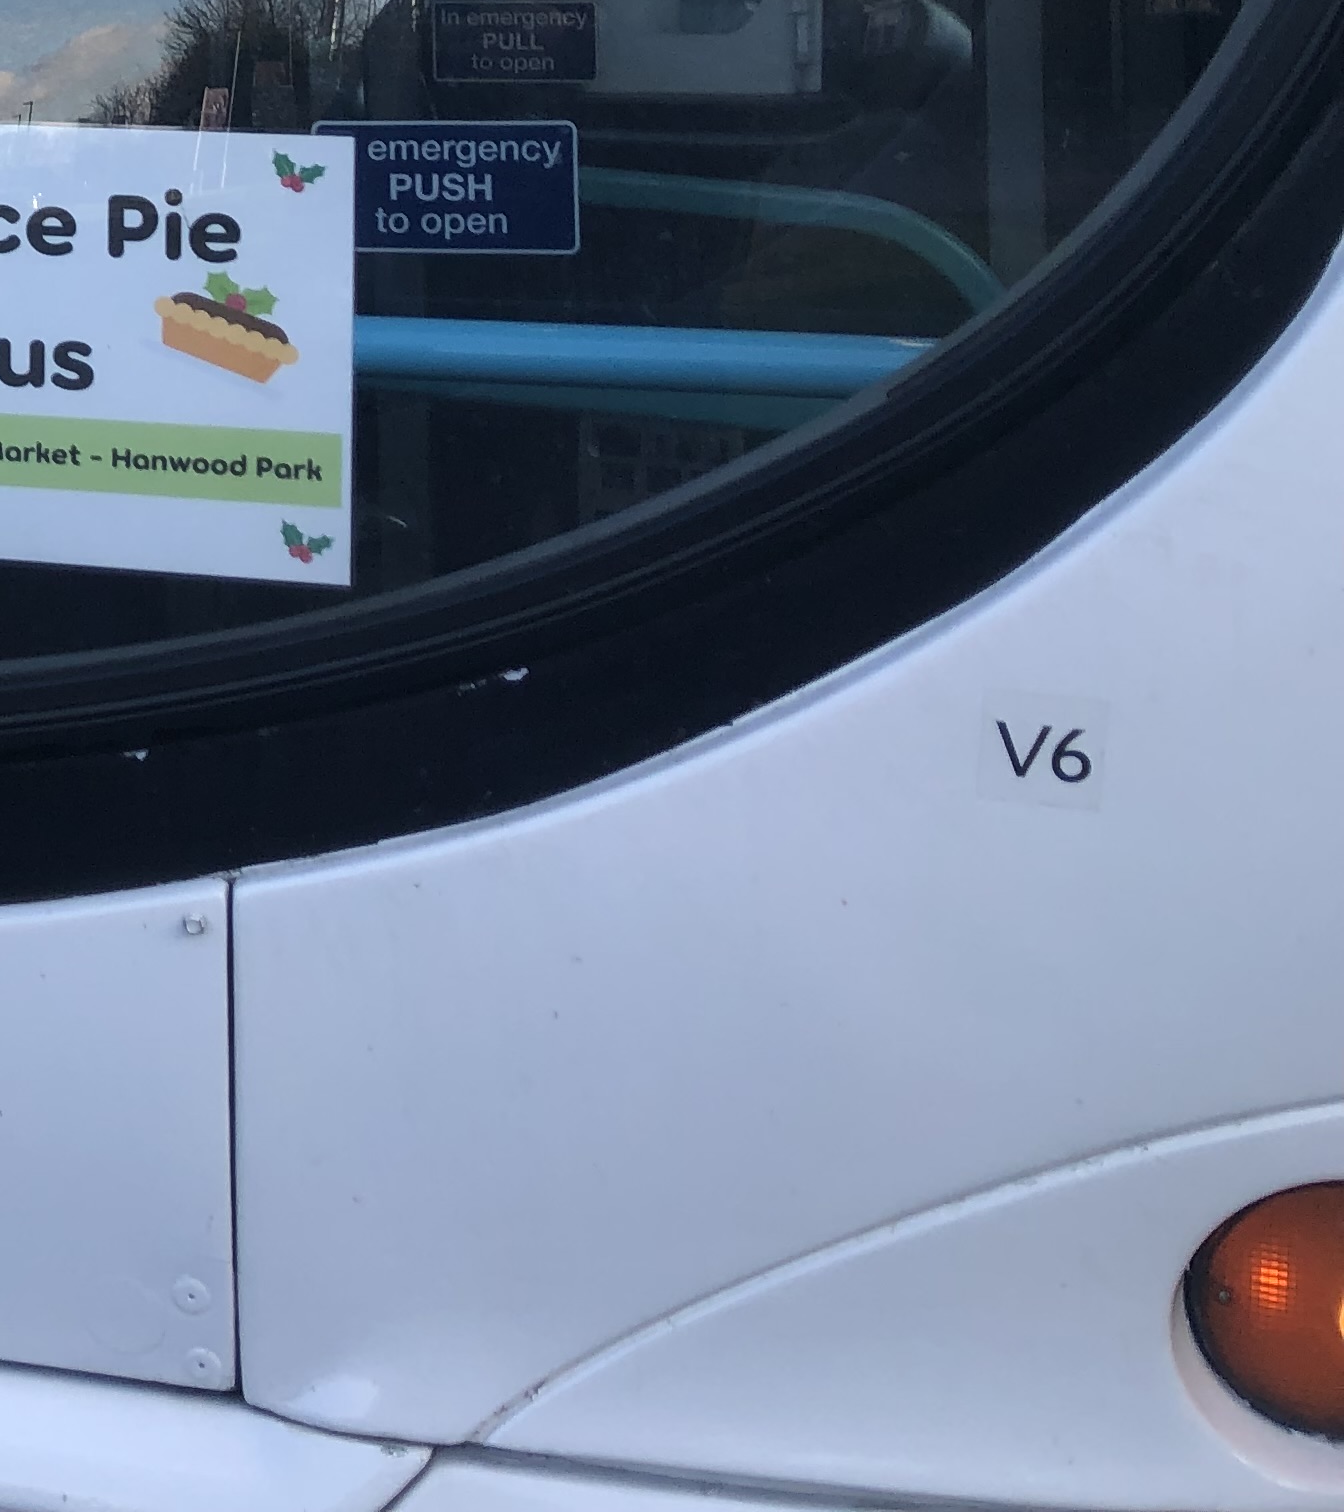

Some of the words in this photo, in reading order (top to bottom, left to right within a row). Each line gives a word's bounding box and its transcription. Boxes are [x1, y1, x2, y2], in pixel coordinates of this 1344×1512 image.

[440, 9, 460, 26] In
[466, 9, 587, 30] emergency
[482, 32, 545, 50] PULL
[471, 54, 493, 70] to
[500, 56, 555, 73] open
[367, 139, 562, 169] emergency
[389, 172, 493, 202] PUSH
[107, 188, 241, 264] Pie
[374, 206, 410, 234] to
[420, 212, 508, 240] open
[111, 447, 248, 478] Hanwood
[256, 456, 323, 482] Park
[995, 720, 1092, 784] V6
